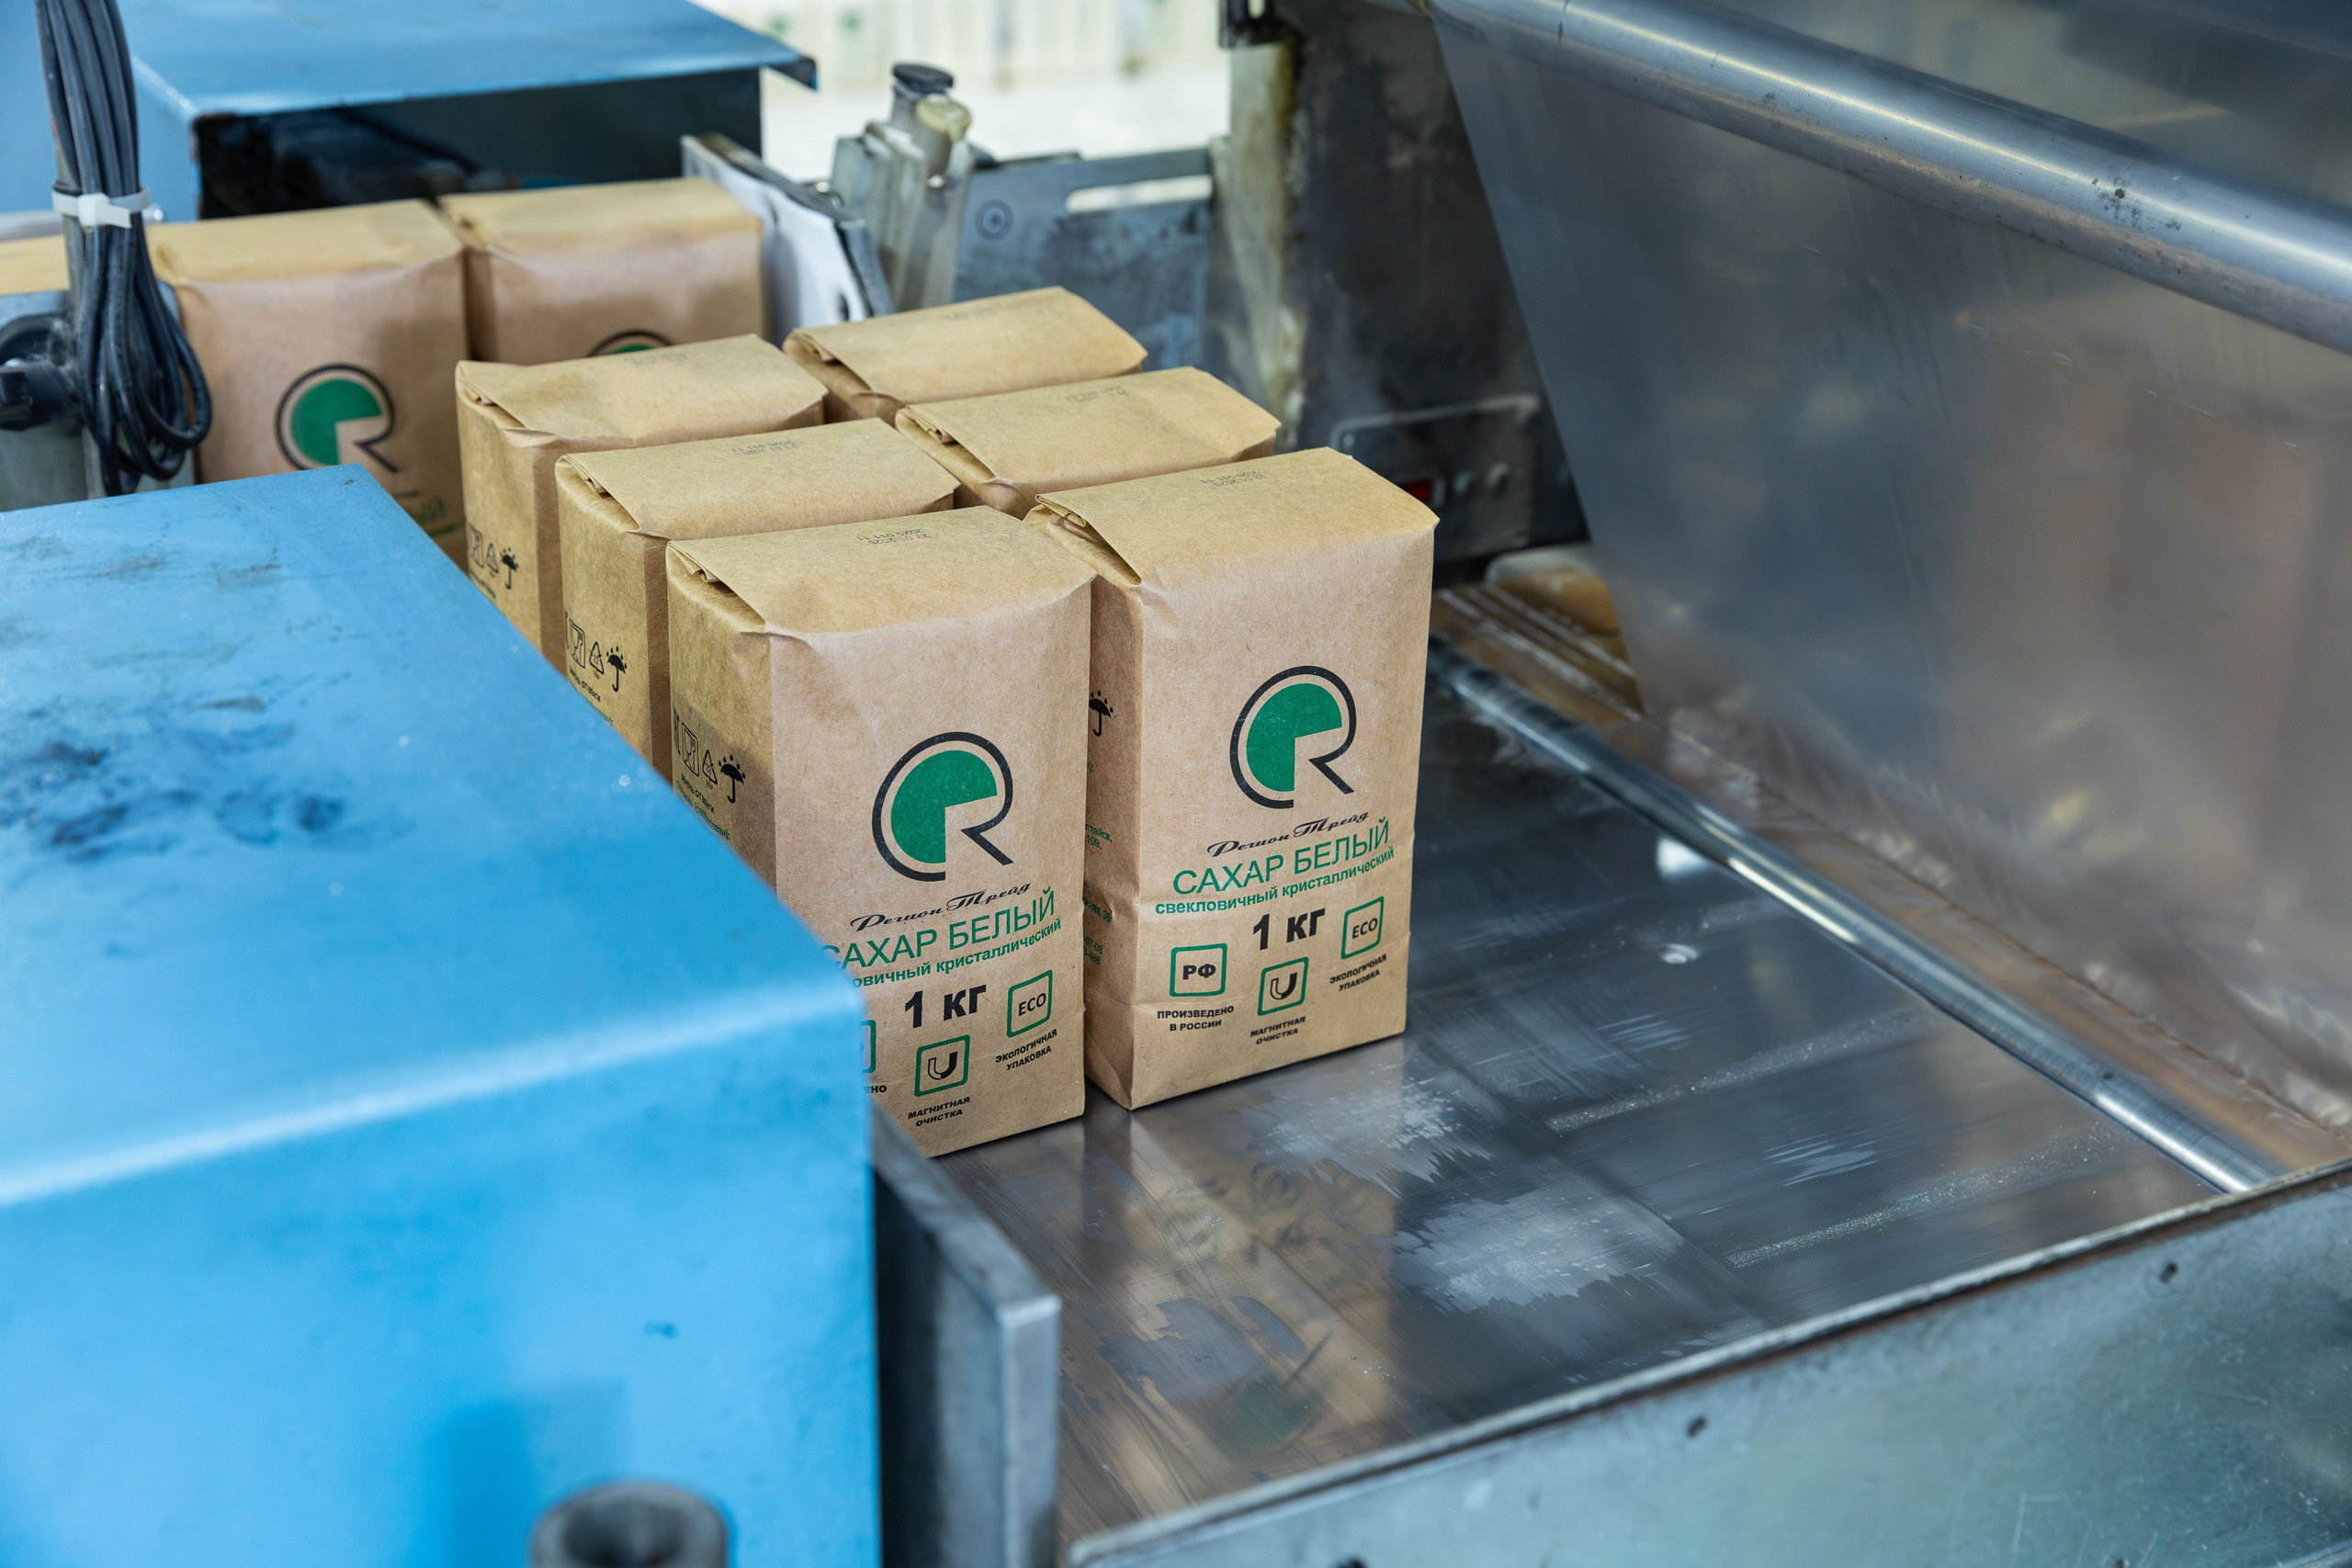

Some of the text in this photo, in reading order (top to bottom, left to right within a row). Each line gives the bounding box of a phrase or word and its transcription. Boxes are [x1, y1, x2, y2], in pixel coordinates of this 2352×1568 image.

[1207, 812, 1369, 858] Регион Трейд
[1172, 816, 1389, 895] САХАР БЕЛЫЙ
[1156, 846, 1395, 915] свекловичный кристаллический
[850, 882, 1031, 931] Регион Трейд
[949, 886, 1055, 950] БЕЛЫЙ
[1253, 913, 1270, 950] 1
[1351, 918, 1378, 939] ECO
[853, 917, 1061, 988] овичный кристаллический
[1182, 963, 1216, 980] РФ
[1329, 953, 1387, 985] ЭКОЛОГИЧНАЯ
[1338, 969, 1380, 992] УПАКОВКА
[904, 990, 922, 1029] 1
[1018, 992, 1046, 1017] ECO
[1157, 1005, 1235, 1020] ПРОИЗВЕДЕНО
[1180, 1020, 1222, 1031] РОССИИ
[1250, 1016, 1306, 1037] МАГНИТНАЯ
[1255, 1027, 1299, 1045] ОЧИСТКА
[995, 1029, 1057, 1064] ЭКОЛОГИЧНАЯ
[1006, 1045, 1051, 1070] УПАКОВКА
[908, 1097, 970, 1119] МАГНИТНАЯ
[915, 1109, 963, 1126] ОЧИСТКА
